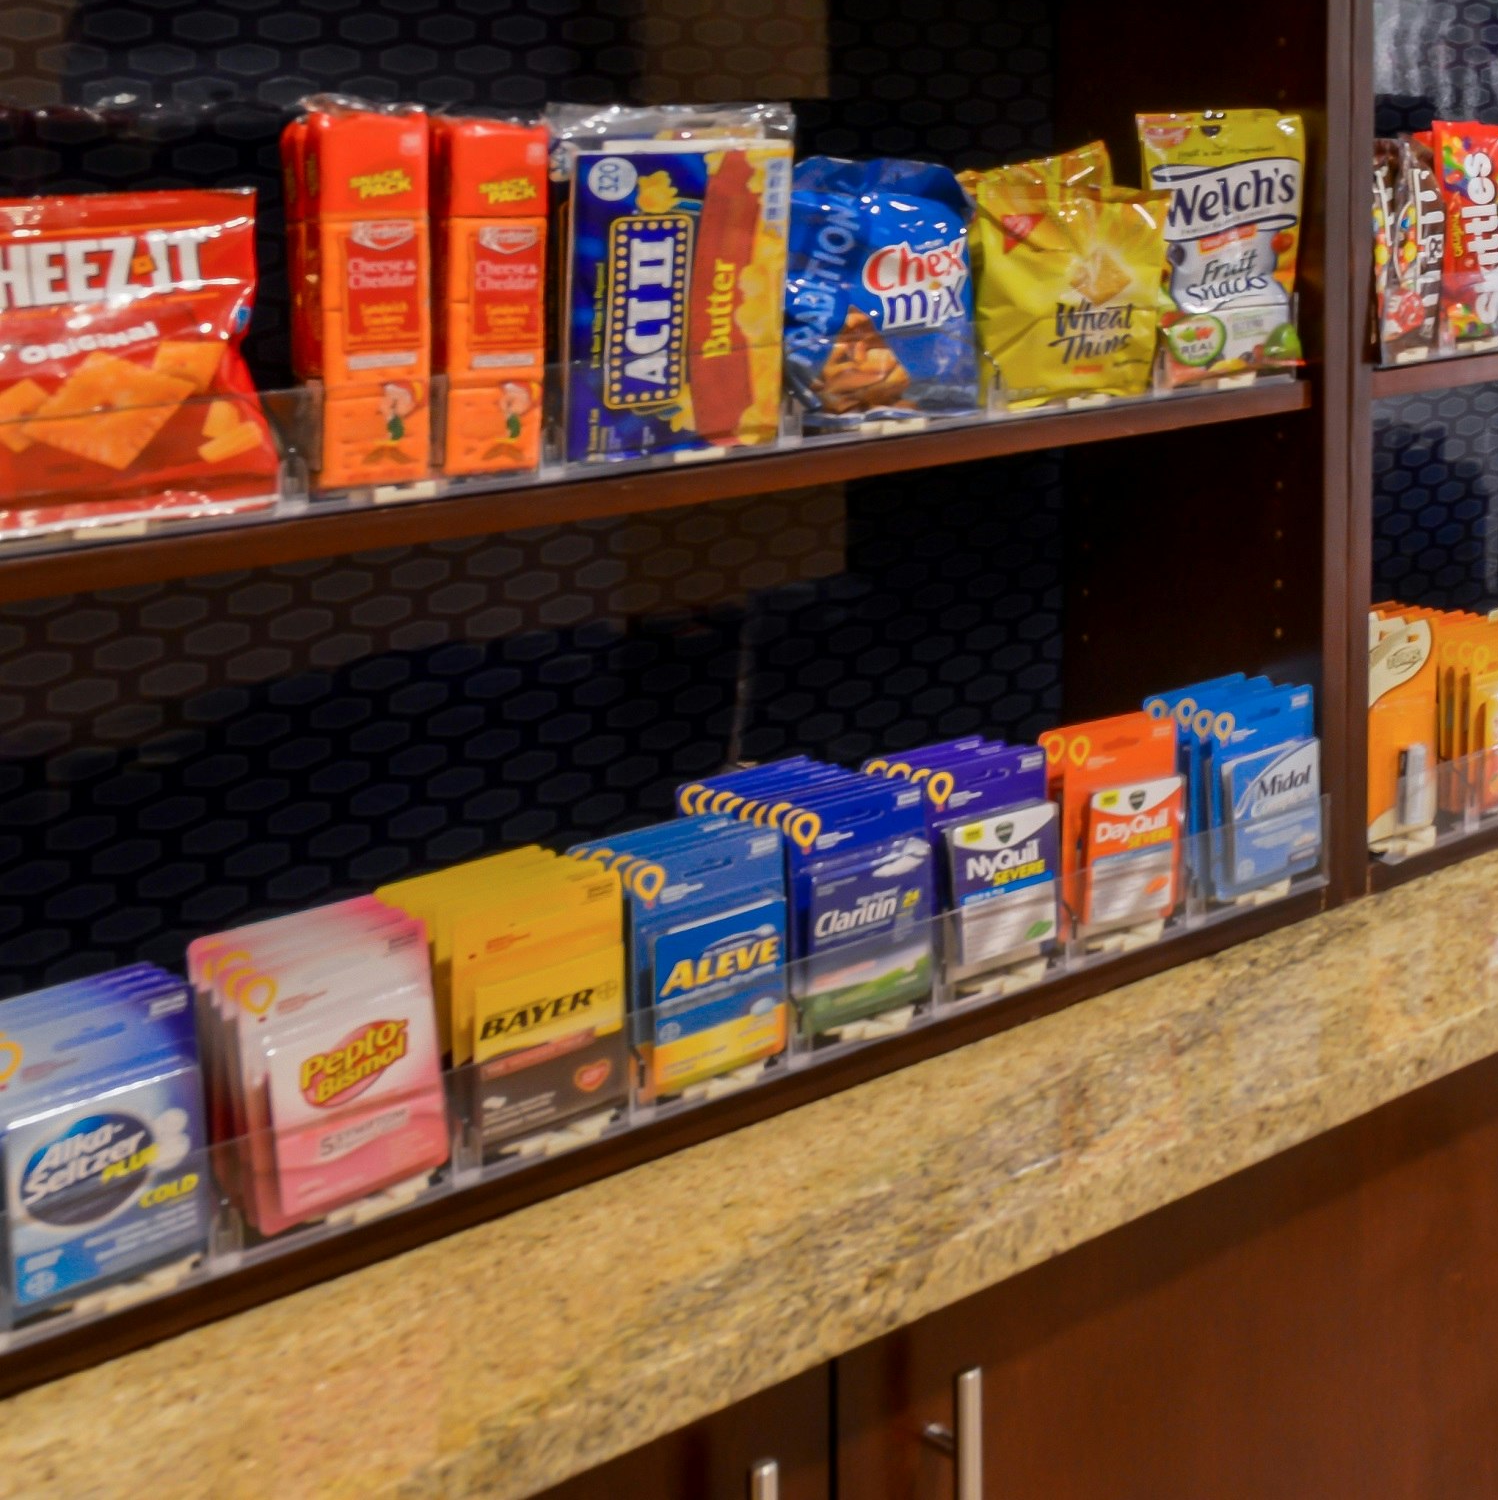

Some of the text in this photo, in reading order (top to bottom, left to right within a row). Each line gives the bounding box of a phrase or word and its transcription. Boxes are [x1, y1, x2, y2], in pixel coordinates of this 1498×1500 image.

[1168, 168, 1296, 228] Welch's
[865, 240, 964, 291] Chex
[1202, 250, 1258, 284] Fruit
[703, 258, 736, 359] Butter
[883, 287, 965, 324] mix
[1055, 299, 1132, 337] Wheat
[624, 297, 672, 385] ACT
[1048, 332, 1132, 364] Thins
[1257, 764, 1311, 801] Midol
[1095, 809, 1169, 842] DayQuil
[965, 839, 1040, 880] NyQuil
[993, 859, 1046, 886] SEVERE
[814, 896, 898, 939] Claritin
[659, 937, 782, 998] ALEVE
[478, 988, 595, 1042] BAYER
[316, 1034, 405, 1104] Bismol
[138, 1173, 199, 1210] COLD
